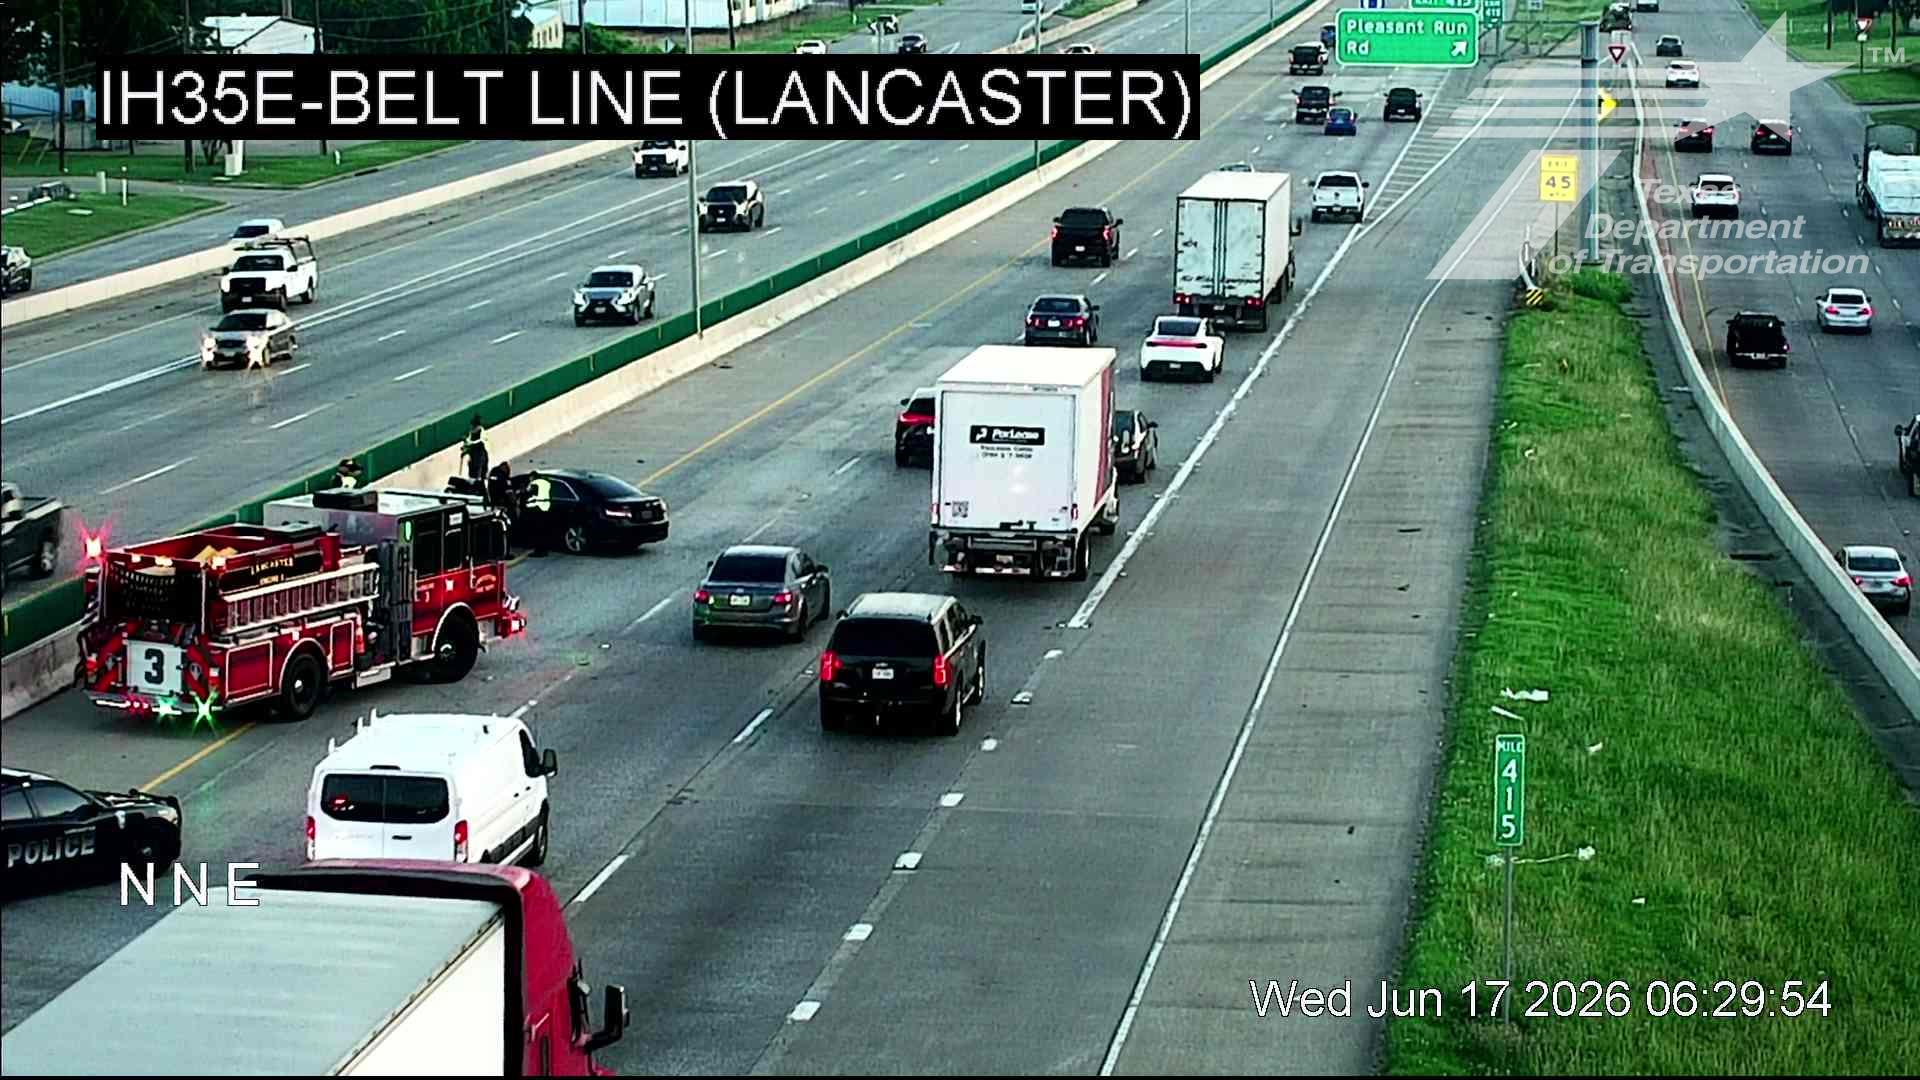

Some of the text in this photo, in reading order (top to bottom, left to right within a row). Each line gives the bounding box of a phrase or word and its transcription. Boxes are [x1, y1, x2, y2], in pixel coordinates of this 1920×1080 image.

[1346, 19, 1468, 35] Pleasant Run
[1346, 40, 1370, 55] Rd
[1545, 175, 1571, 189] 45
[144, 648, 164, 685] 3
[7, 832, 96, 868] POLICE
